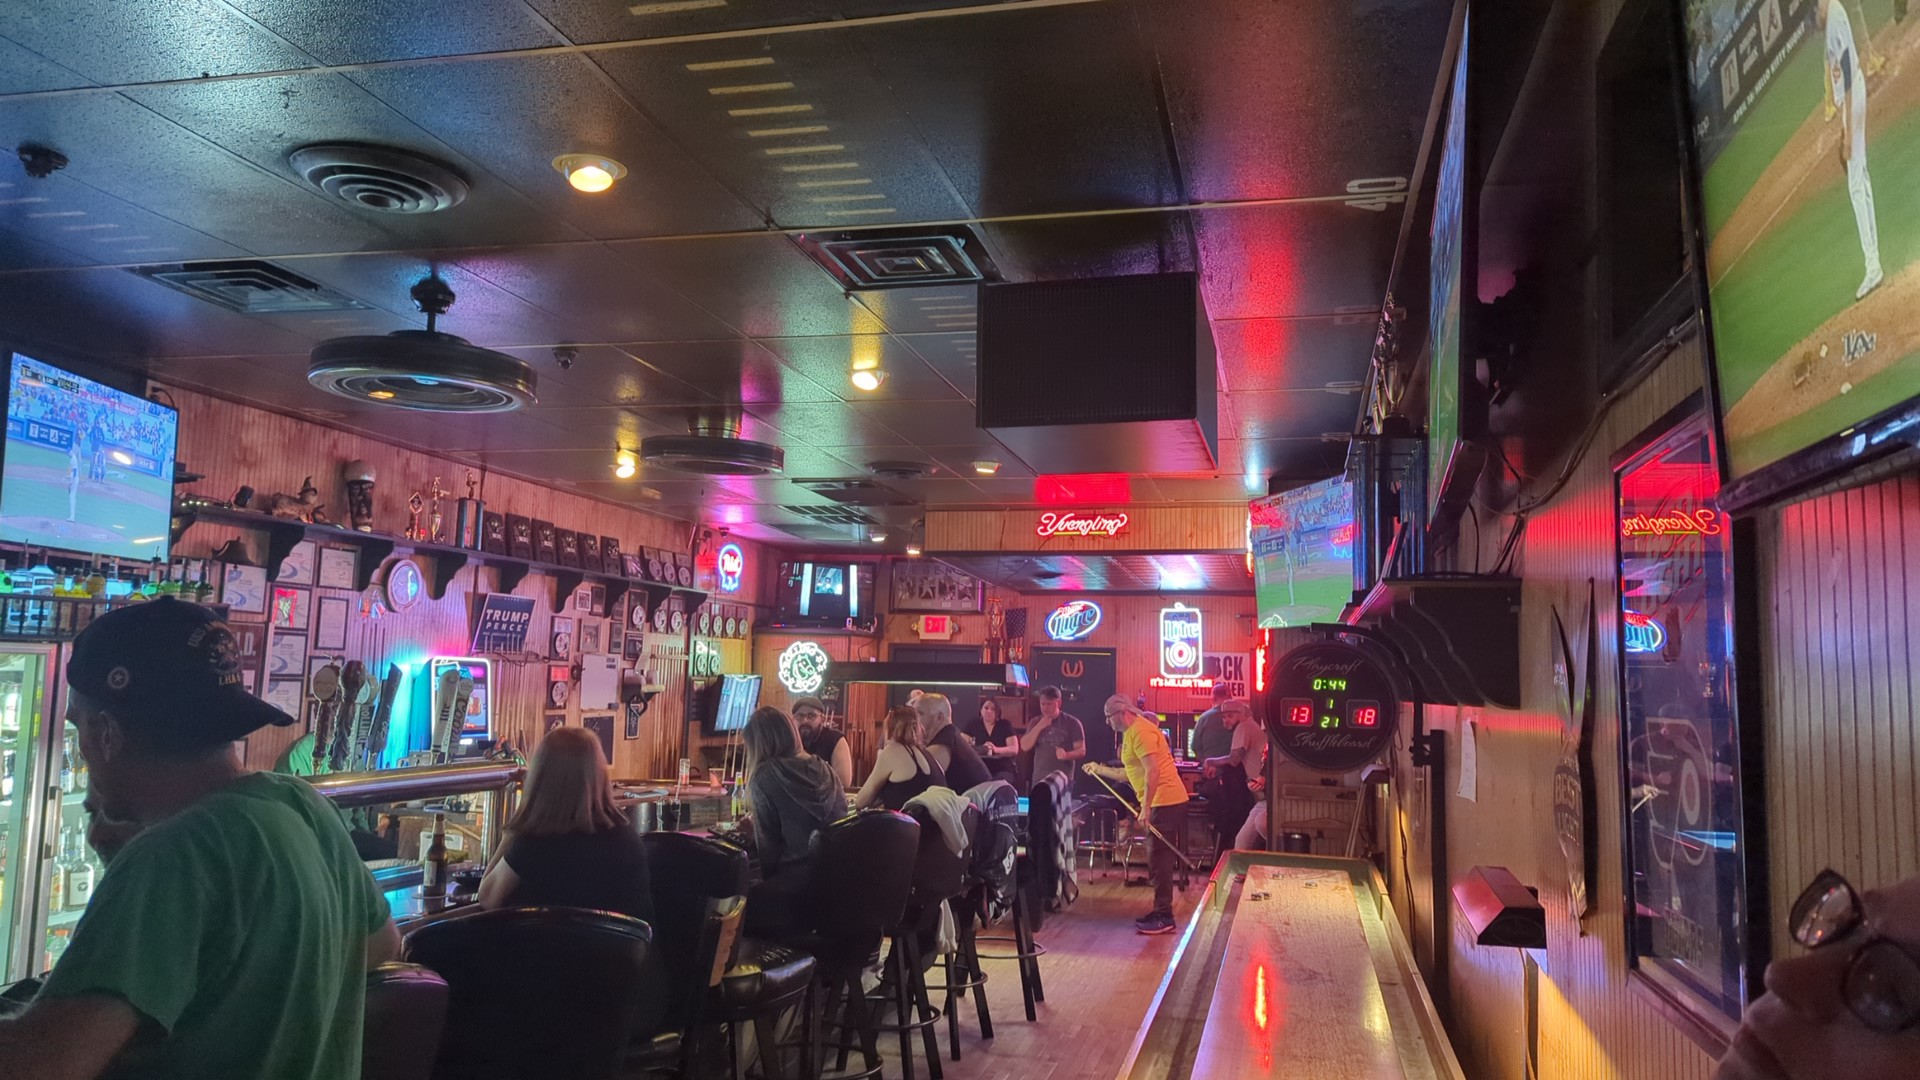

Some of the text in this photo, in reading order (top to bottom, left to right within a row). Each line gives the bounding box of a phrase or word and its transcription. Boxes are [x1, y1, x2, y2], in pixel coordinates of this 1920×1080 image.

[1037, 513, 1128, 536] Yuengling
[486, 609, 530, 624] TRUMP
[924, 615, 948, 633] EXIT
[1053, 608, 1096, 640] Lite
[486, 622, 523, 632] PENCE
[1292, 656, 1365, 679] Playcraft
[1192, 678, 1213, 688] TIME
[1313, 679, 1347, 691] 0:44
[1290, 706, 1310, 723] 13
[1320, 716, 1340, 728] 21
[1356, 708, 1376, 725] 18
[1291, 732, 1378, 752] Shuffleboard
